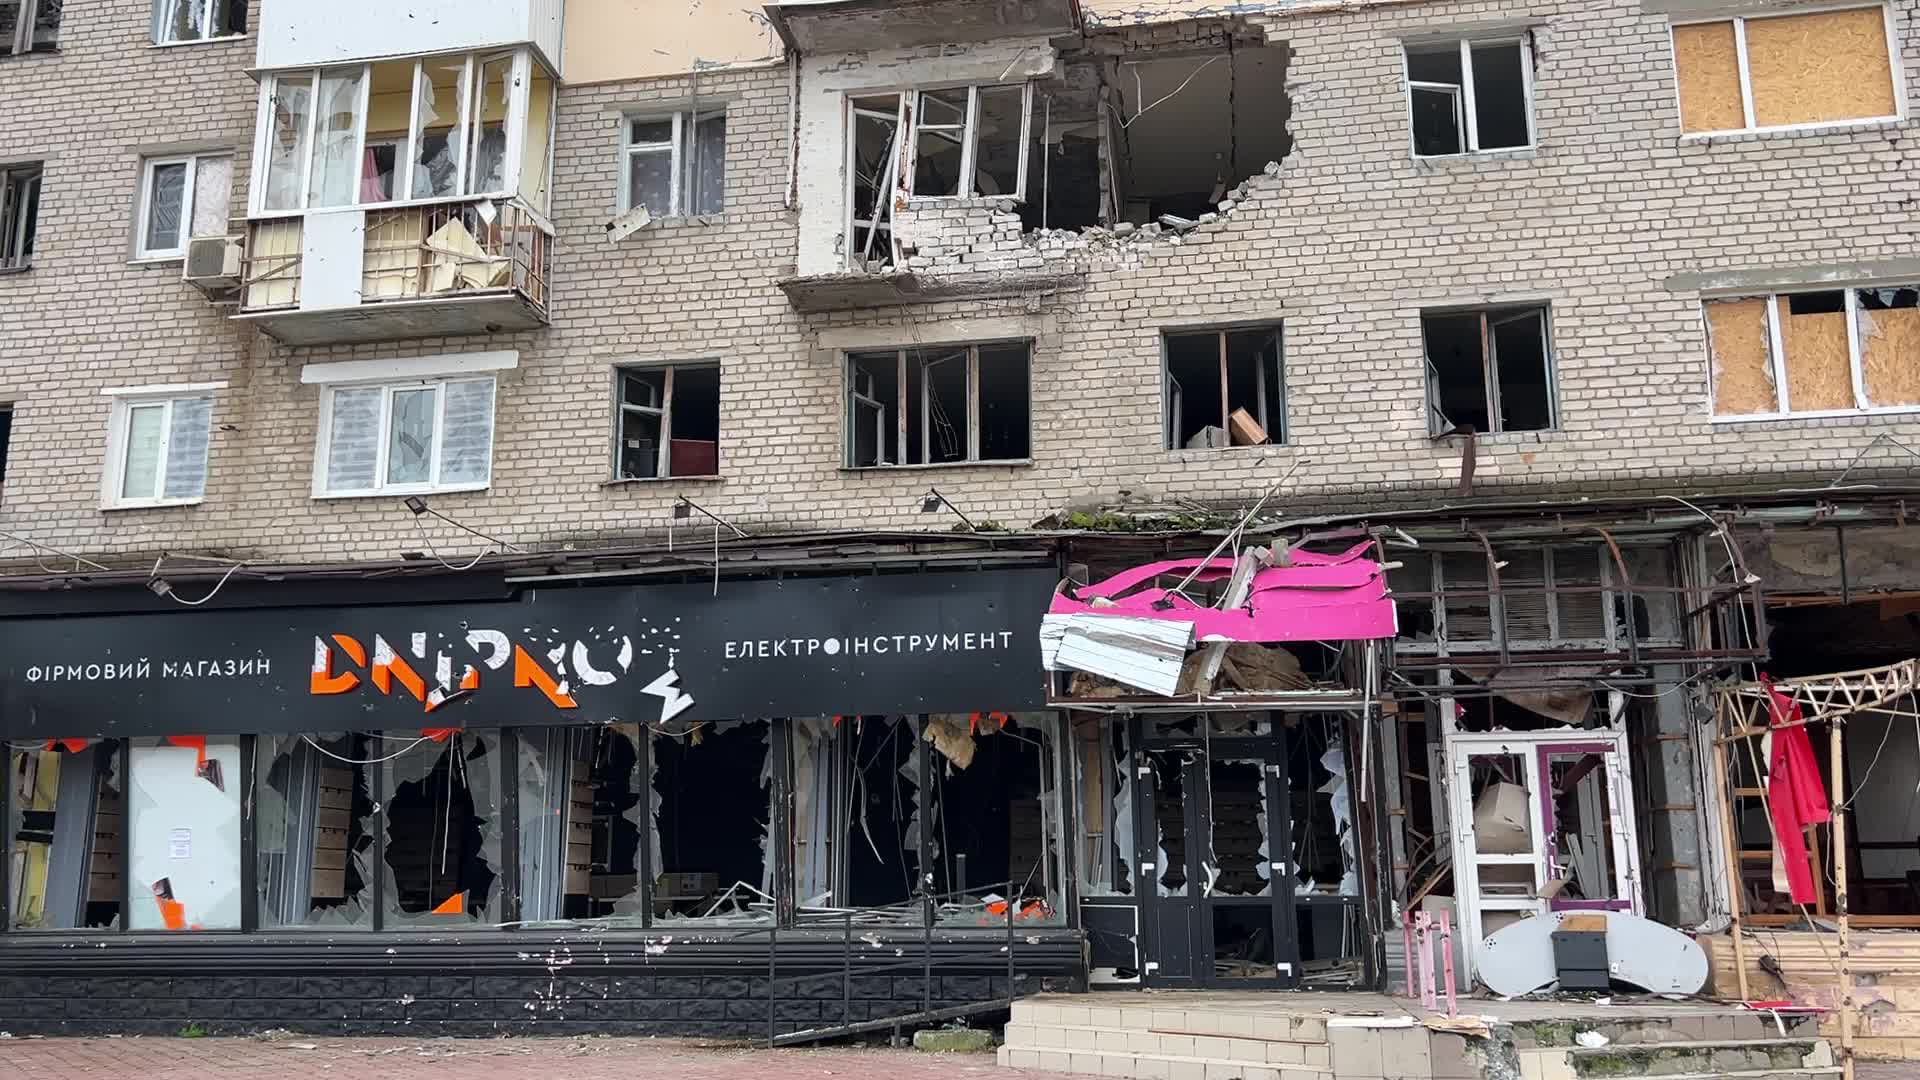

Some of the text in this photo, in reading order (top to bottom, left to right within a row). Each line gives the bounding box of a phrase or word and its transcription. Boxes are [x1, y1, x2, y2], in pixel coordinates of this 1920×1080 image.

[725, 631, 1013, 659] ЕЛЕКТРОІНСТРУМЕНТ
[26, 657, 271, 682] ФІРМОВИЙ МАГАЗИН
